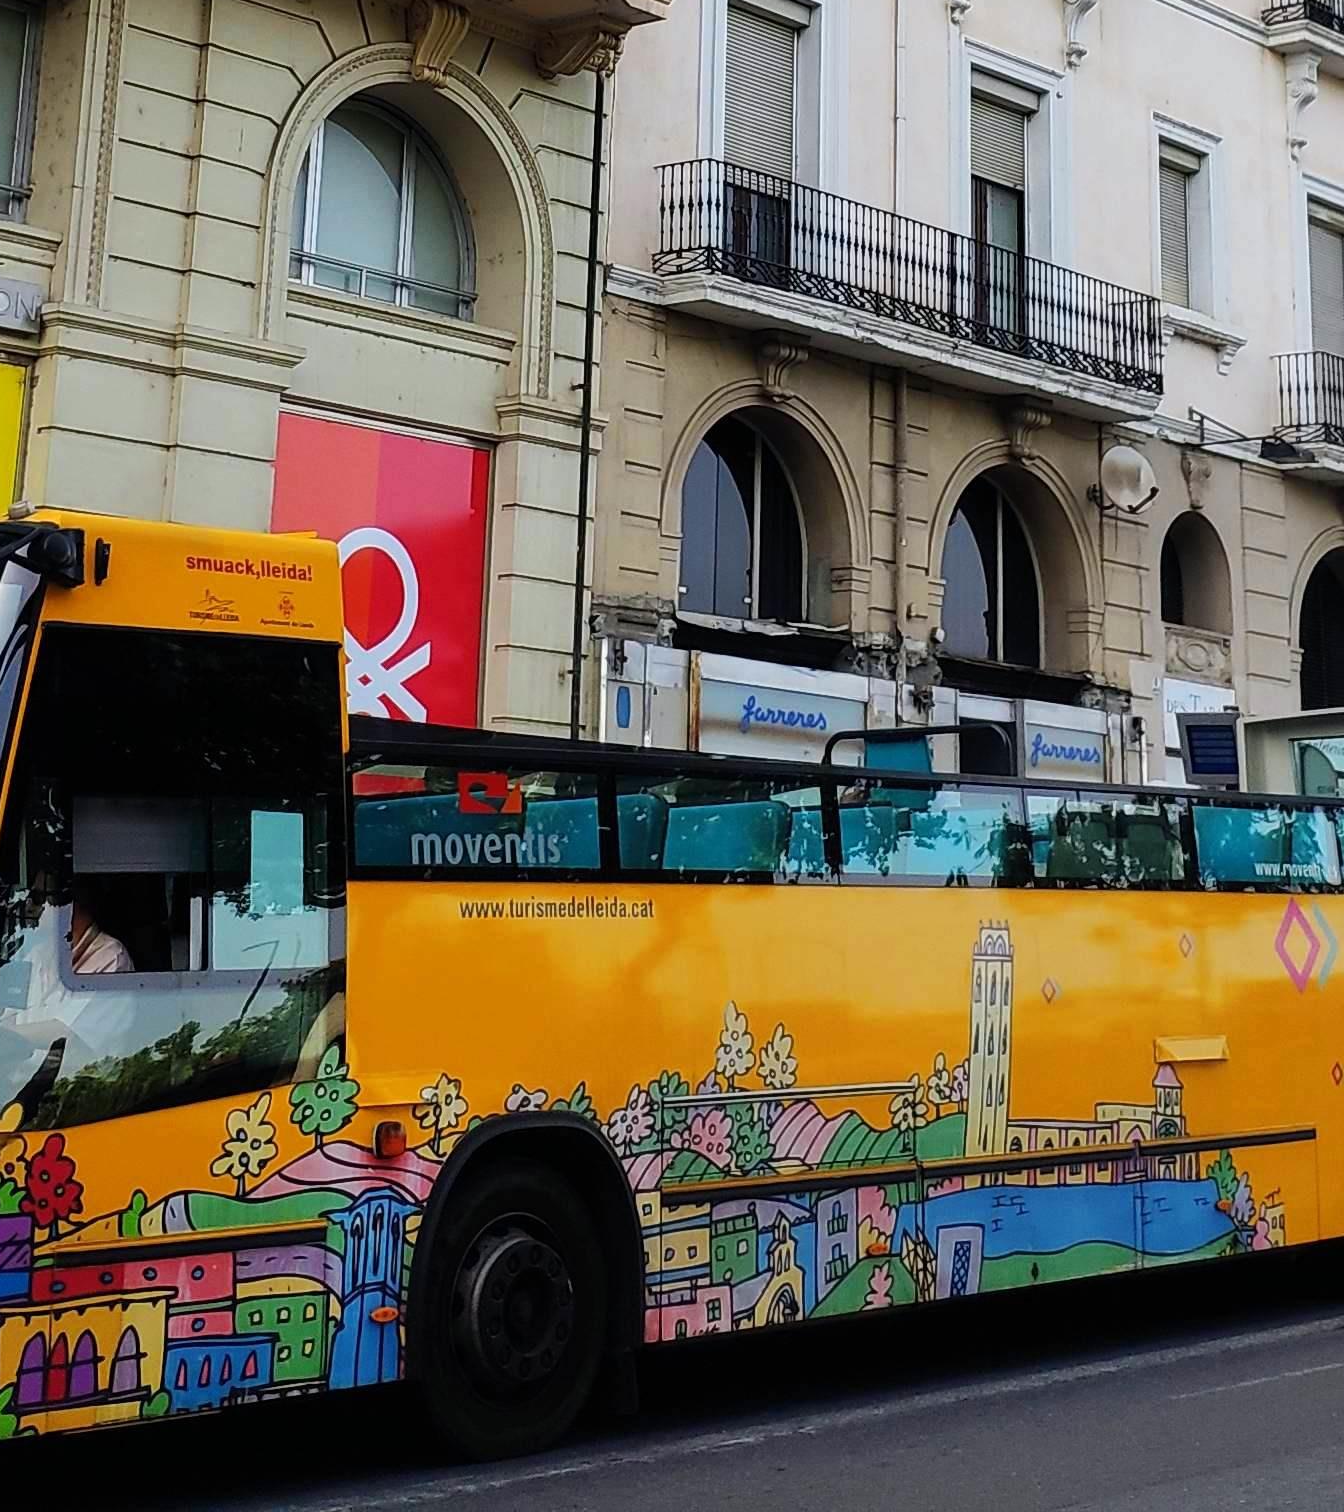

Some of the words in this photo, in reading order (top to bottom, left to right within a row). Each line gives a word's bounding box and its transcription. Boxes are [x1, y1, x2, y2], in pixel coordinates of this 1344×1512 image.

[186, 556, 313, 582] smuack,lleida!
[741, 695, 828, 734] farreres
[1030, 732, 1101, 767] farreres
[411, 831, 562, 865] moventis
[460, 896, 654, 919] www.turismedelleida.cat
